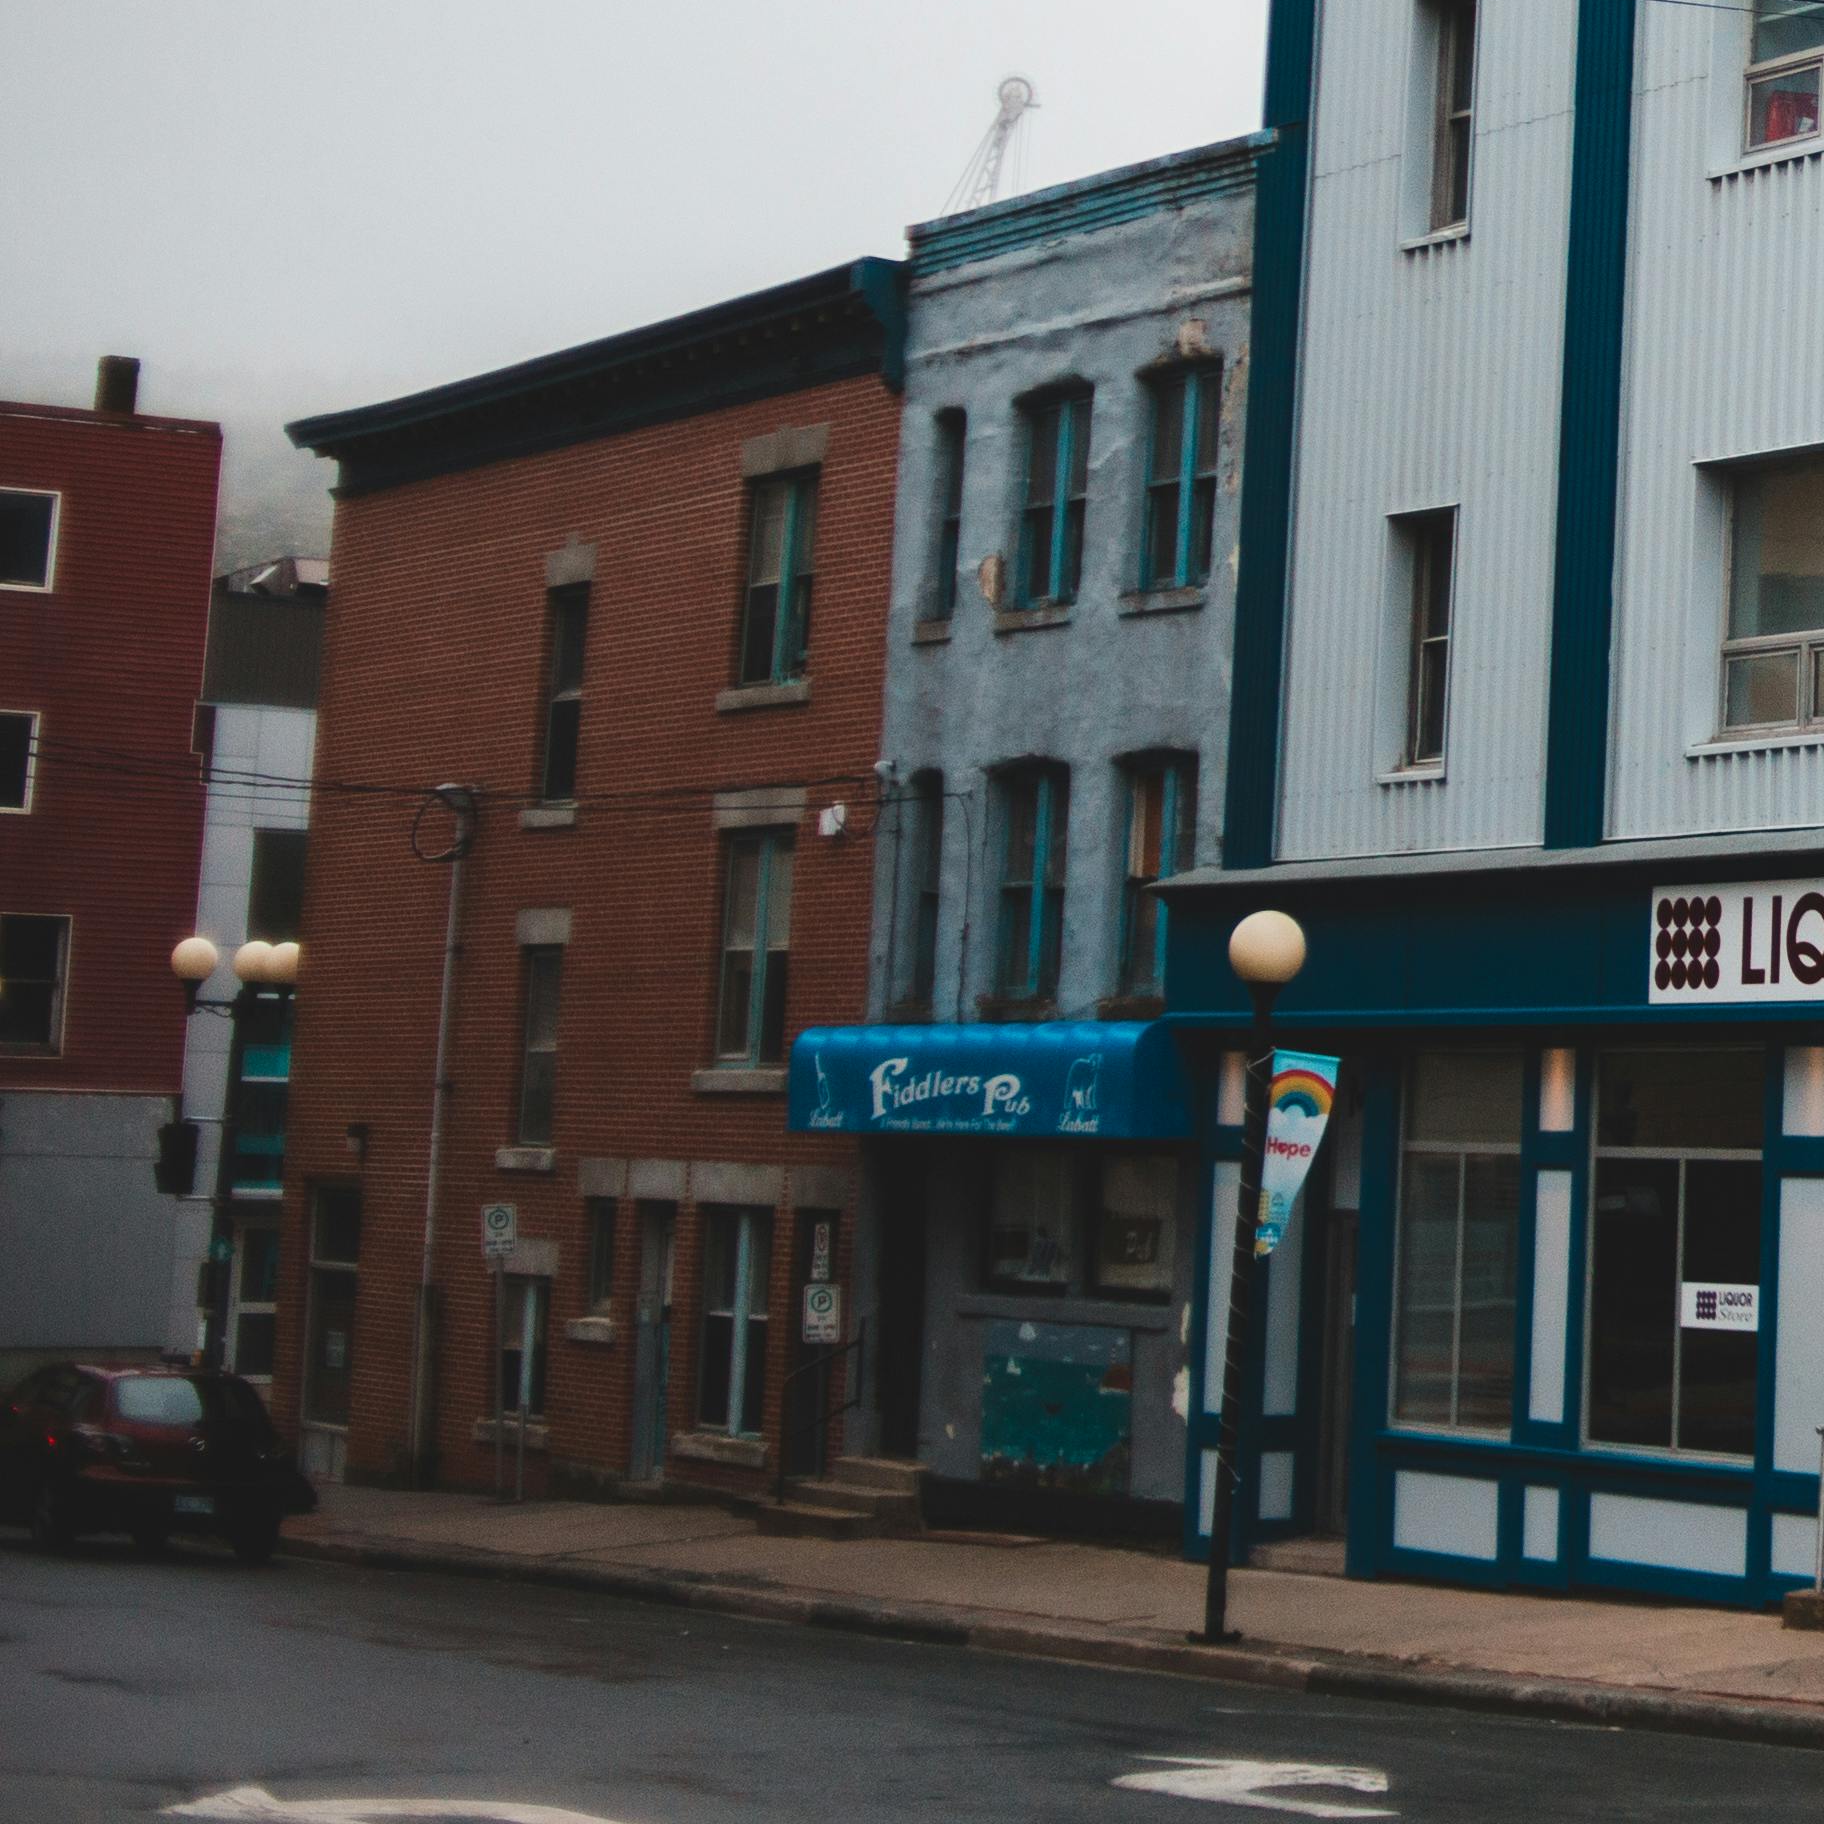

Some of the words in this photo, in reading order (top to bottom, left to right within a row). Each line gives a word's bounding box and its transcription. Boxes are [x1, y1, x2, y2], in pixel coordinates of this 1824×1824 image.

[869, 1057, 981, 1120] Fiddlers
[982, 1074, 1031, 1115] Pub
[1719, 1291, 1753, 1307] LIQUOR
